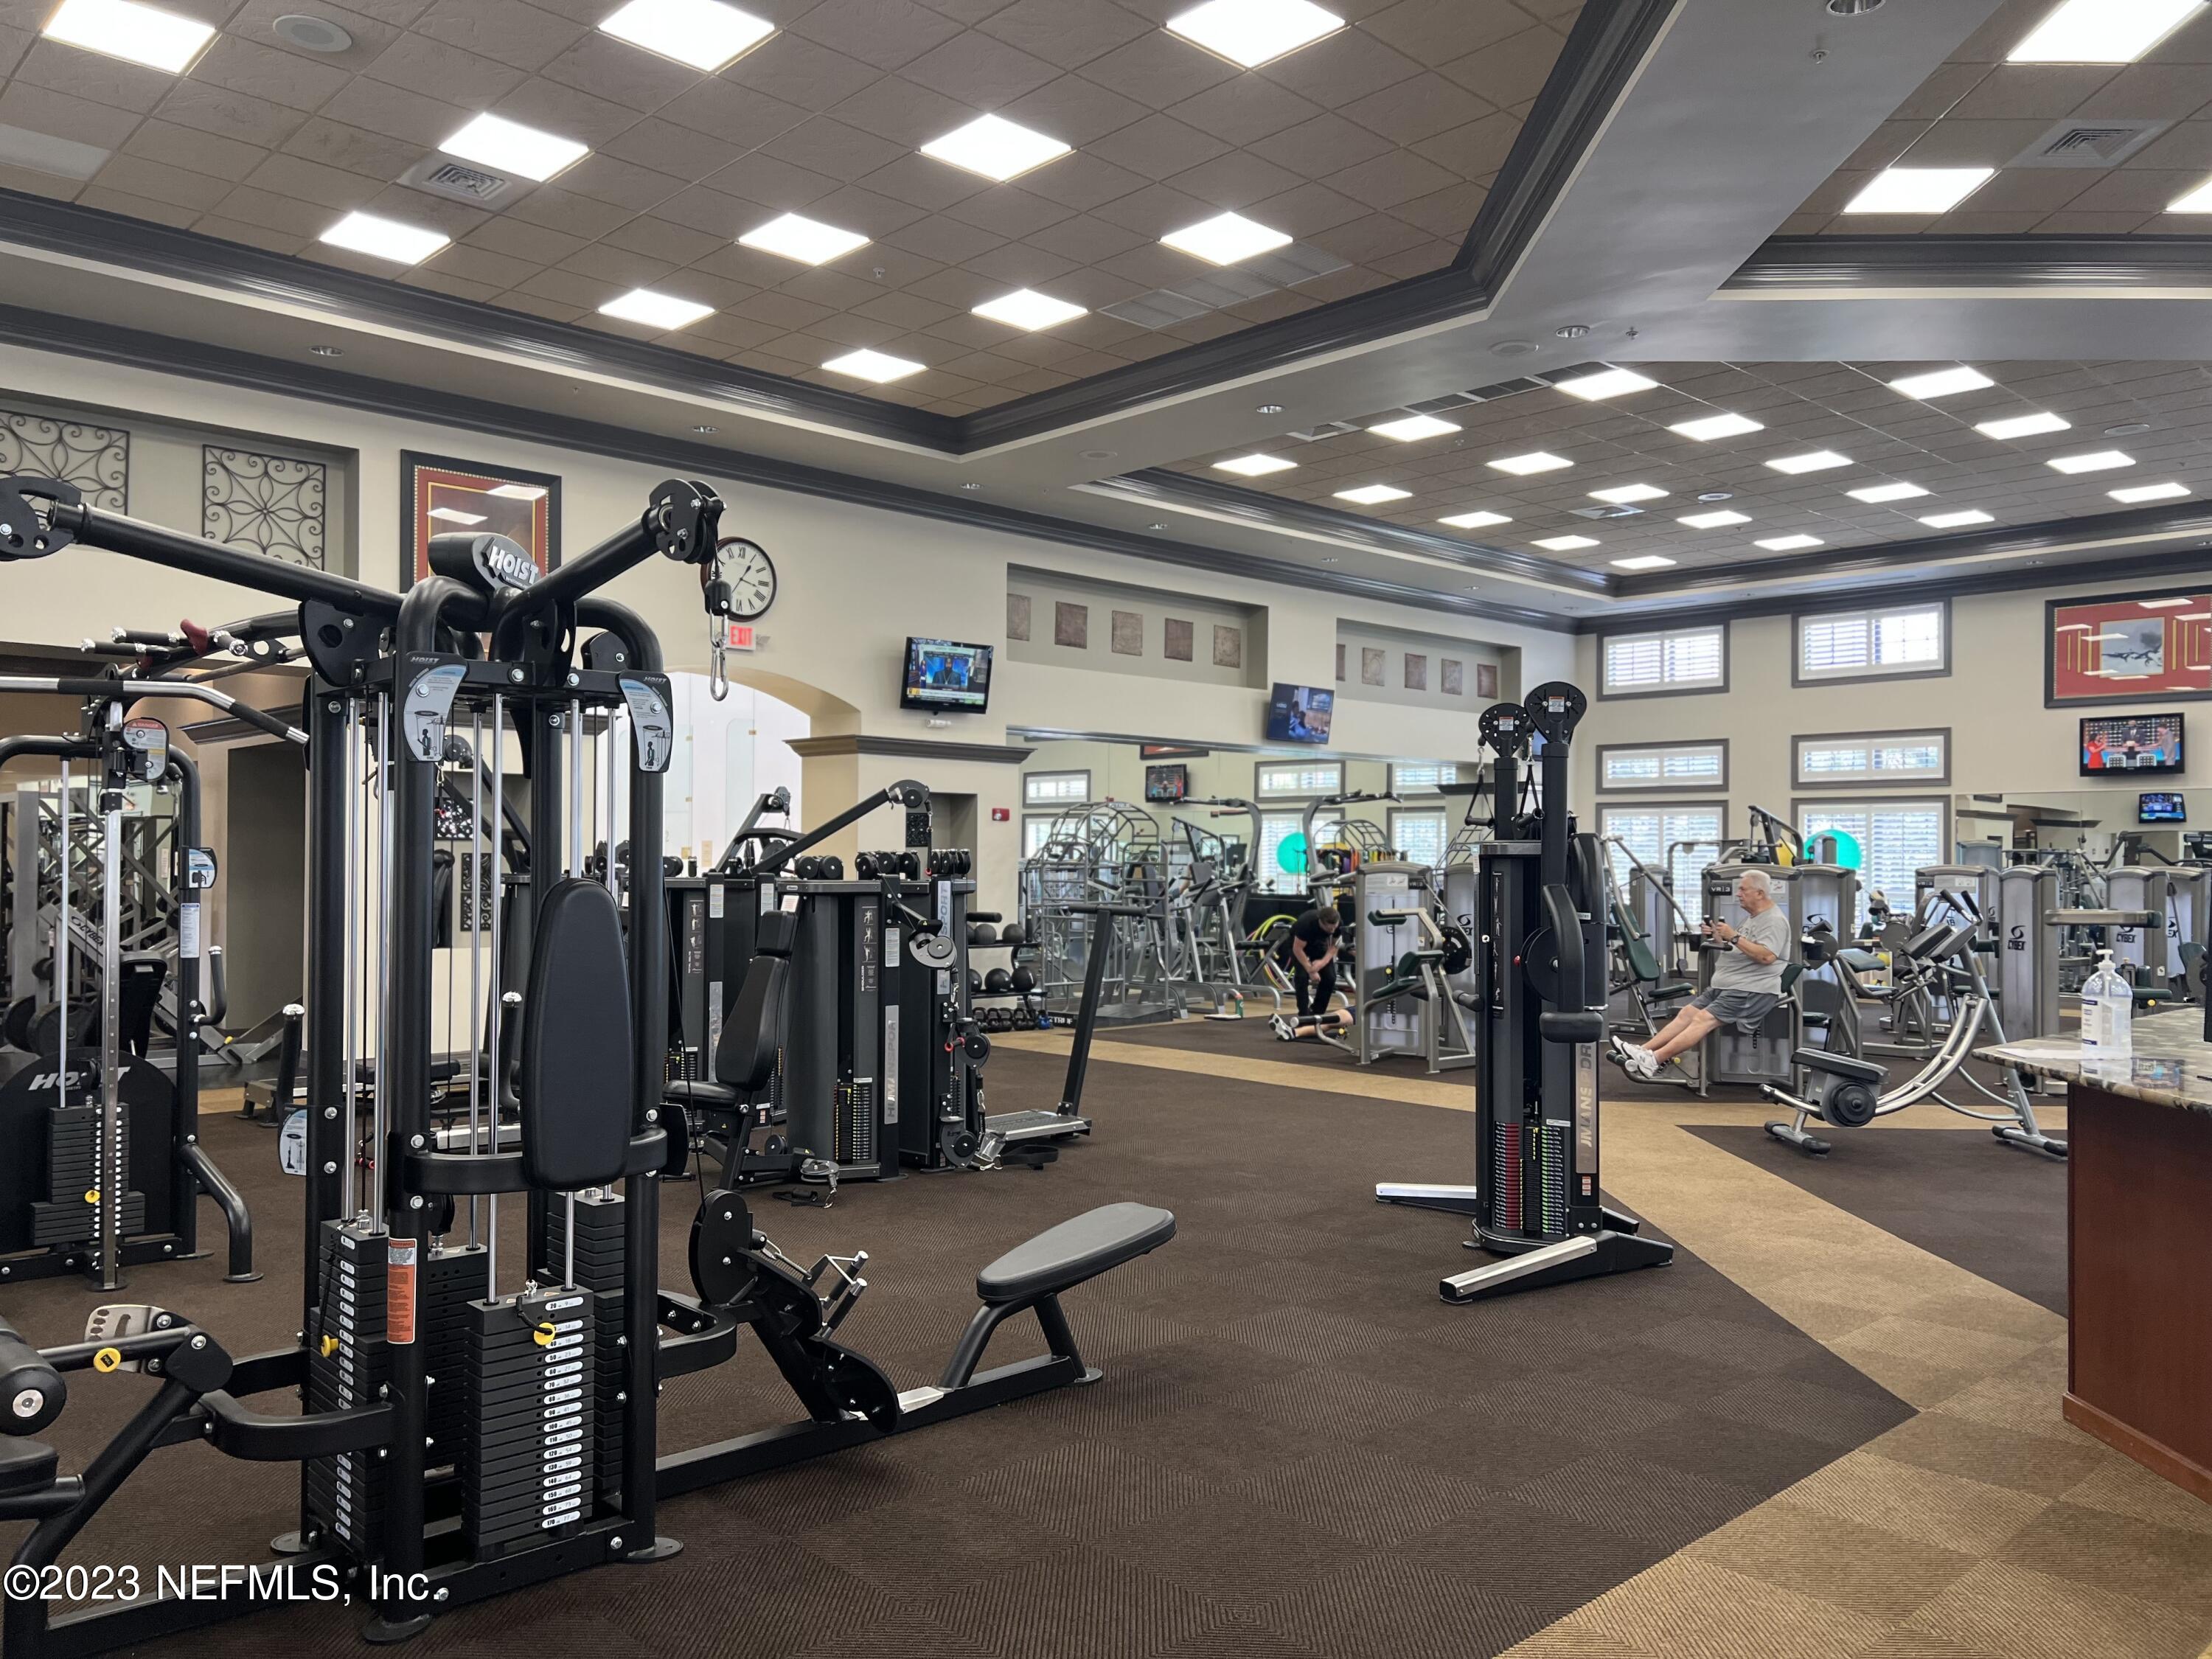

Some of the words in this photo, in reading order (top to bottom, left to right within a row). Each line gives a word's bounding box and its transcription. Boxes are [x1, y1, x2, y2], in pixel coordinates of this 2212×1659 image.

[489, 545, 539, 585] HOIST
[730, 625, 753, 647] EXIT
[2008, 939, 2026, 951] CYBEX
[2116, 933, 2136, 944] CYBEX
[28, 1066, 131, 1091] HOT
